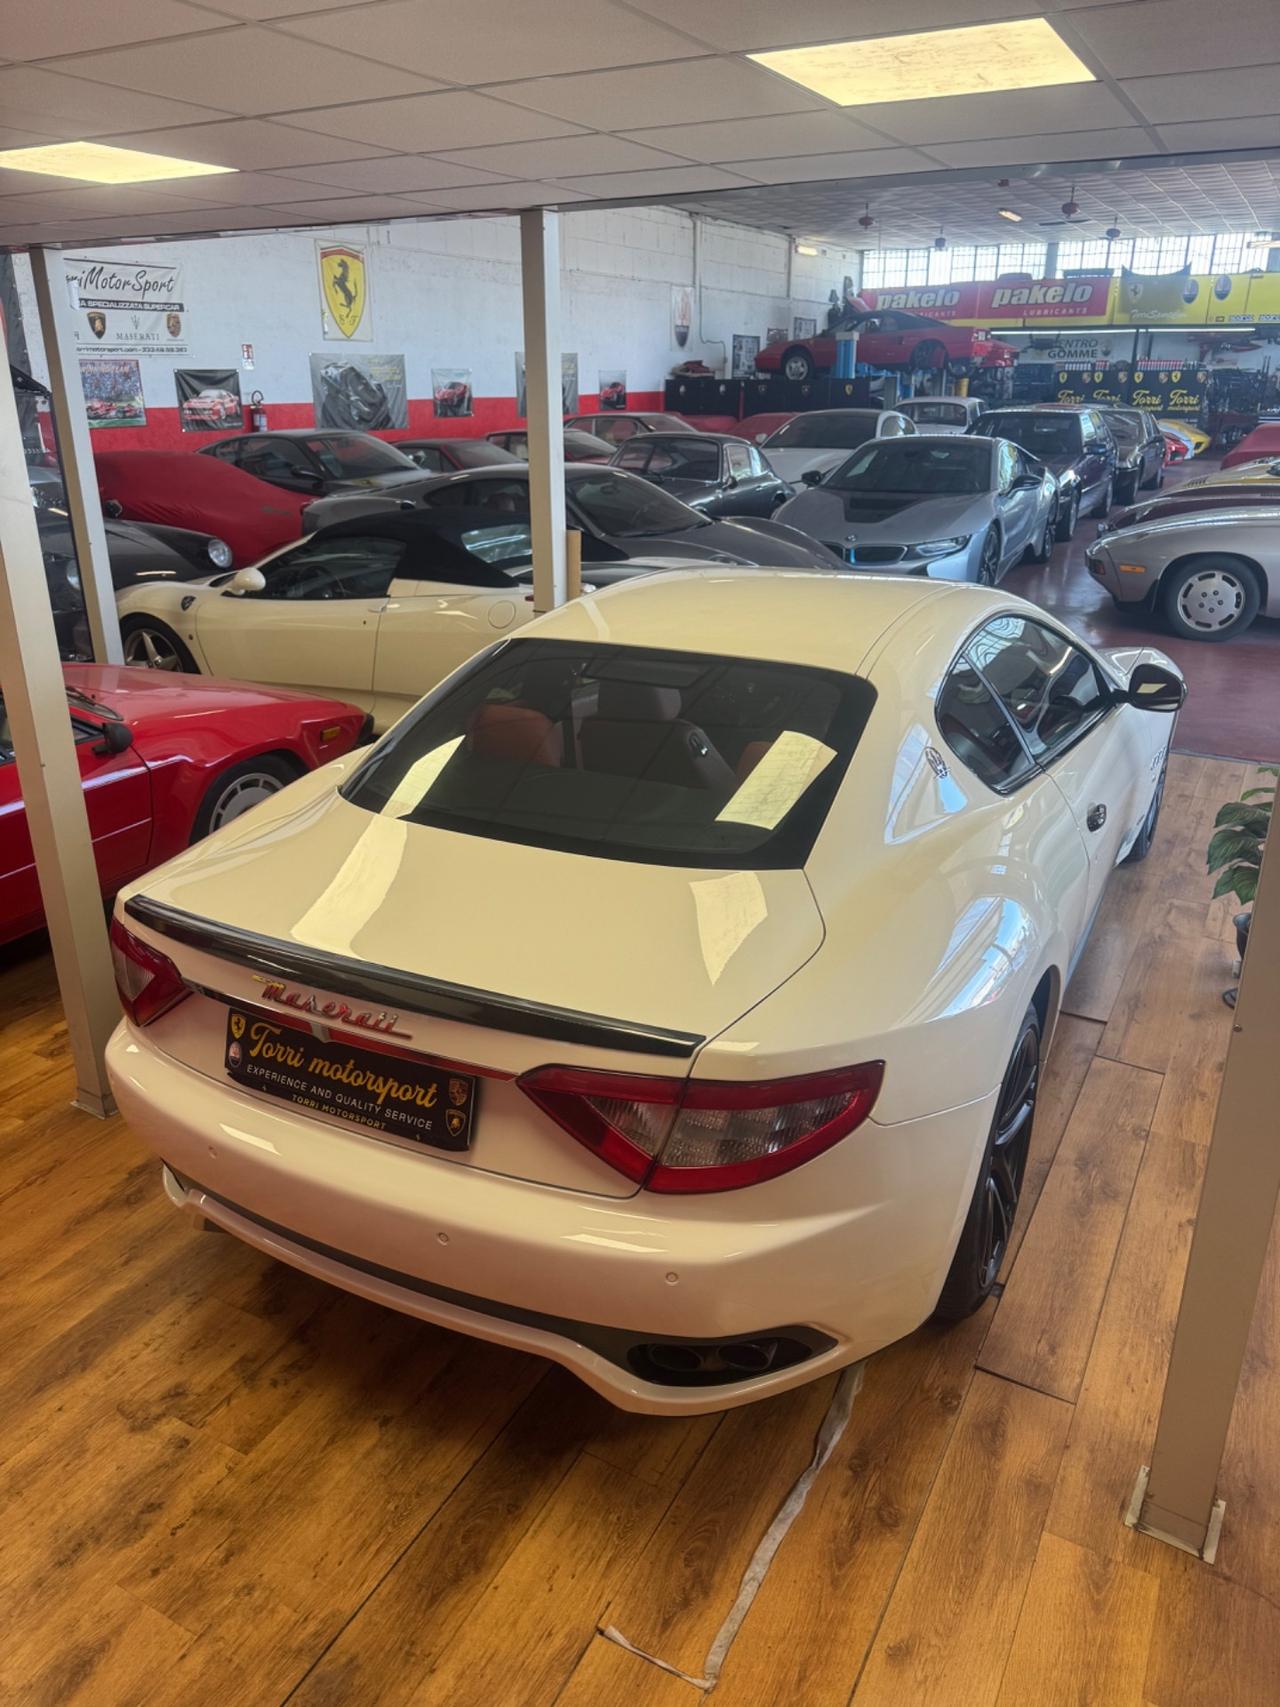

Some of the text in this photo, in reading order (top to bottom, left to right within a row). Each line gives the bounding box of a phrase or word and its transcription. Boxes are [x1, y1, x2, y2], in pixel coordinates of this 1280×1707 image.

[876, 289, 960, 310] pakelo
[992, 283, 1093, 308] pakelo
[1023, 306, 1089, 317] LUBRICANTS
[116, 332, 160, 341] MASERATI
[1058, 338, 1099, 348] ENTRO
[1048, 348, 1098, 359] GOMME
[1132, 389, 1163, 405] Torri
[1169, 389, 1200, 405] Torri
[249, 1021, 438, 1109] Torri motorsport
[246, 1064, 433, 1131] EXPERIENCE AND QUALITY SERVICE
[292, 1093, 387, 1131] TORRI MOTORSPORT
